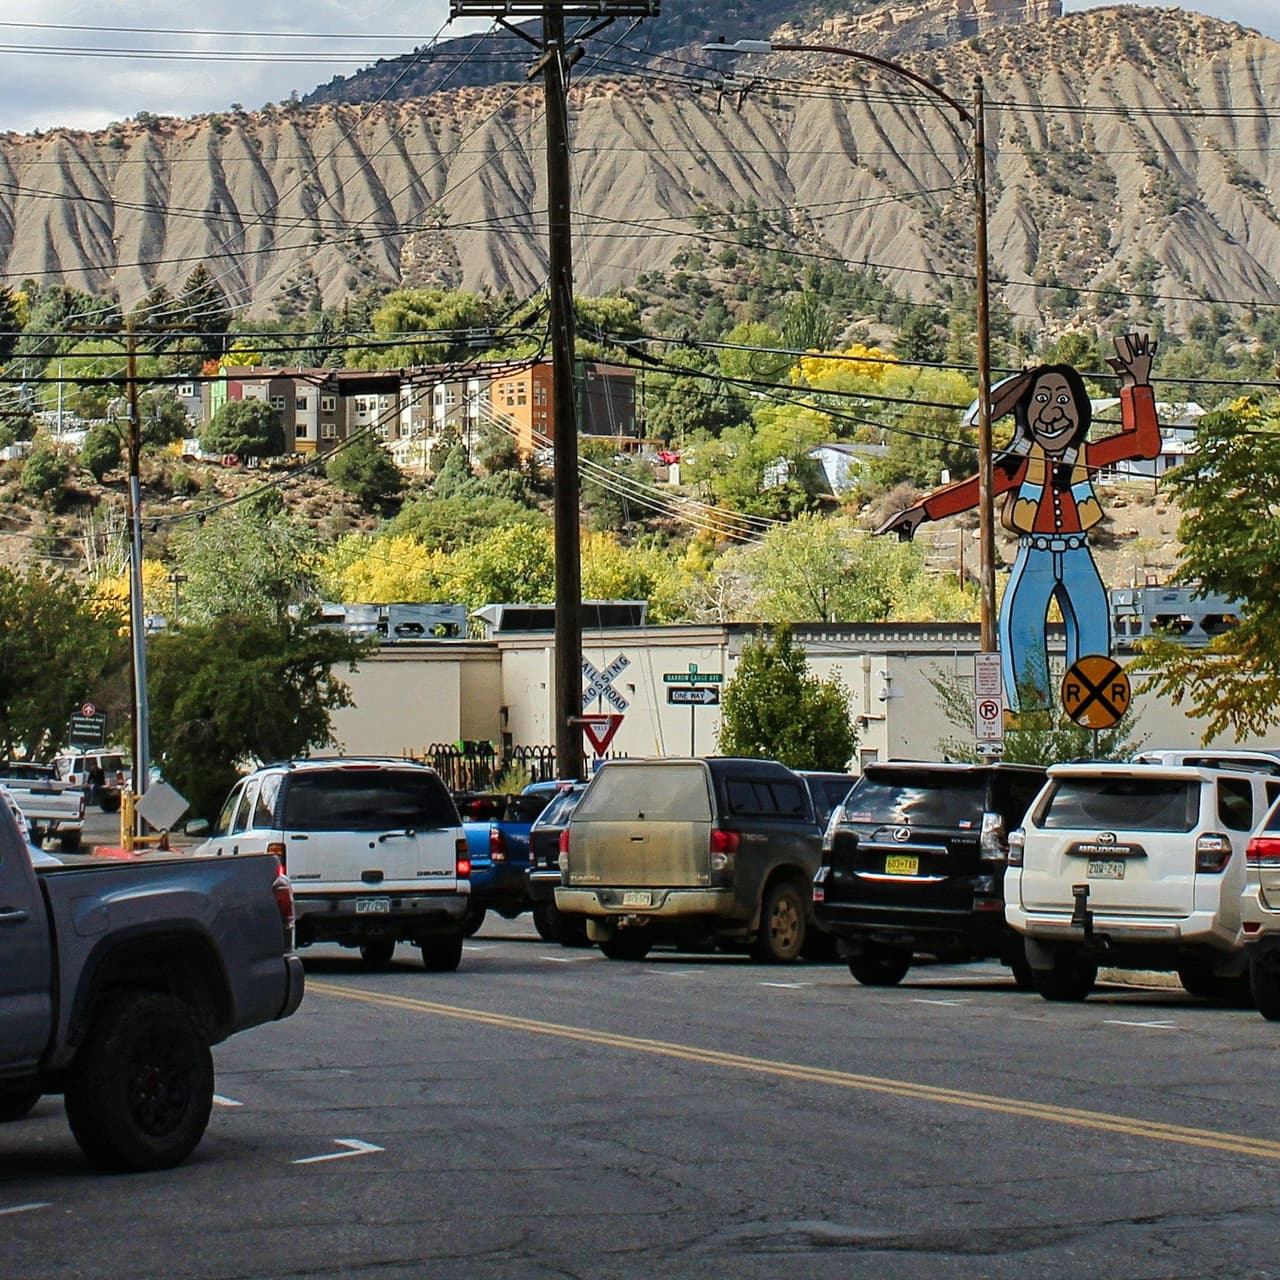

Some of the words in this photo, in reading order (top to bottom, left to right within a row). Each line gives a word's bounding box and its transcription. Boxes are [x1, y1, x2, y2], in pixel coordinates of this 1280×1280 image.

[582, 655, 628, 704] ROSSING
[602, 685, 627, 710] ROAD
[674, 691, 687, 699] ONE
[690, 691, 705, 699] WAY
[1067, 683, 1081, 702] R
[1112, 683, 1126, 702] R
